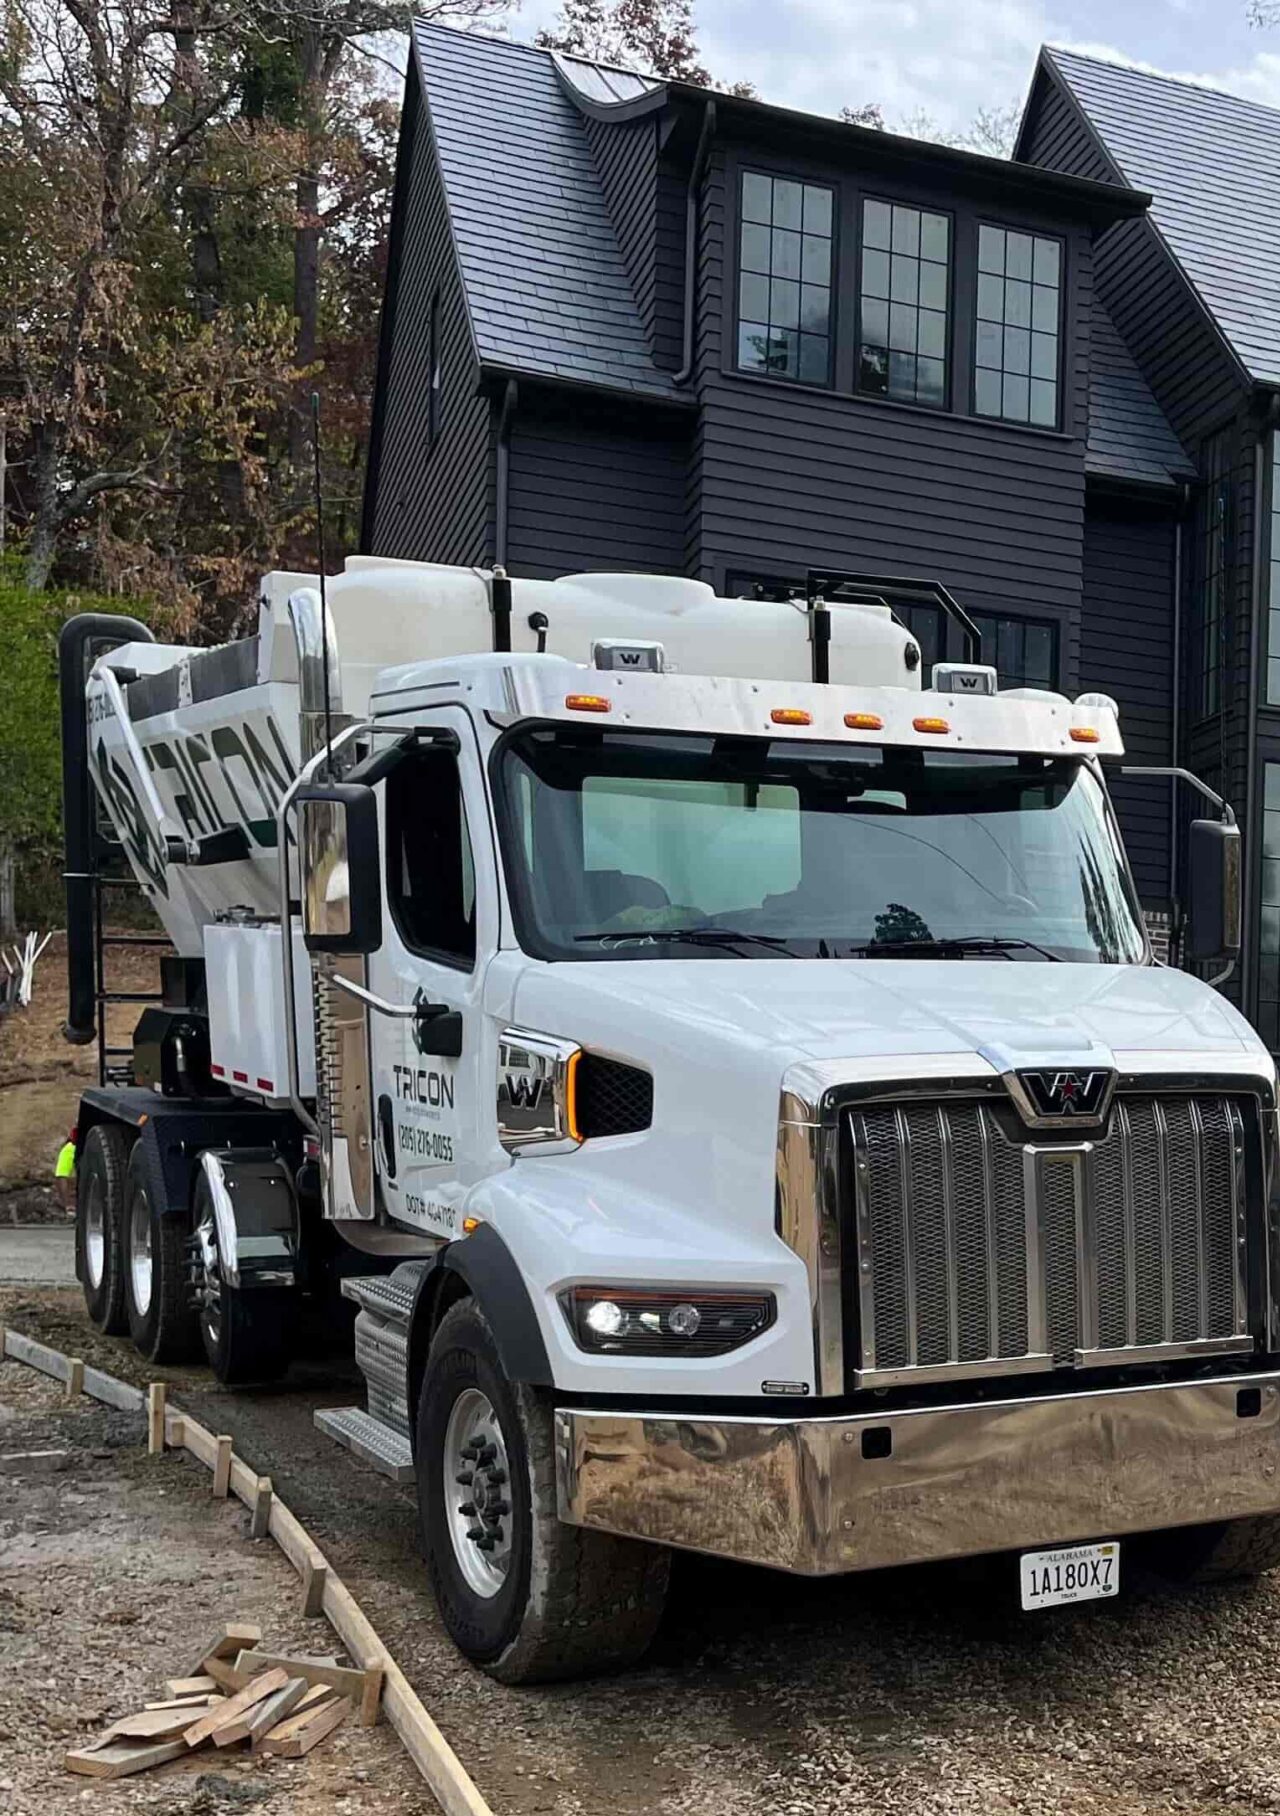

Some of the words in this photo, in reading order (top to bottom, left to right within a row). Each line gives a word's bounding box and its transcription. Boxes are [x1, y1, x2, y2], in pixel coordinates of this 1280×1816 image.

[393, 1064, 454, 1109] TRICON
[398, 1122, 417, 1156] (205)
[417, 1128, 453, 1162] 276-0055
[405, 1193, 426, 1216] DOT#
[1047, 1549, 1093, 1562] ALABAMA
[1029, 1558, 1113, 1597] 1A180X7
